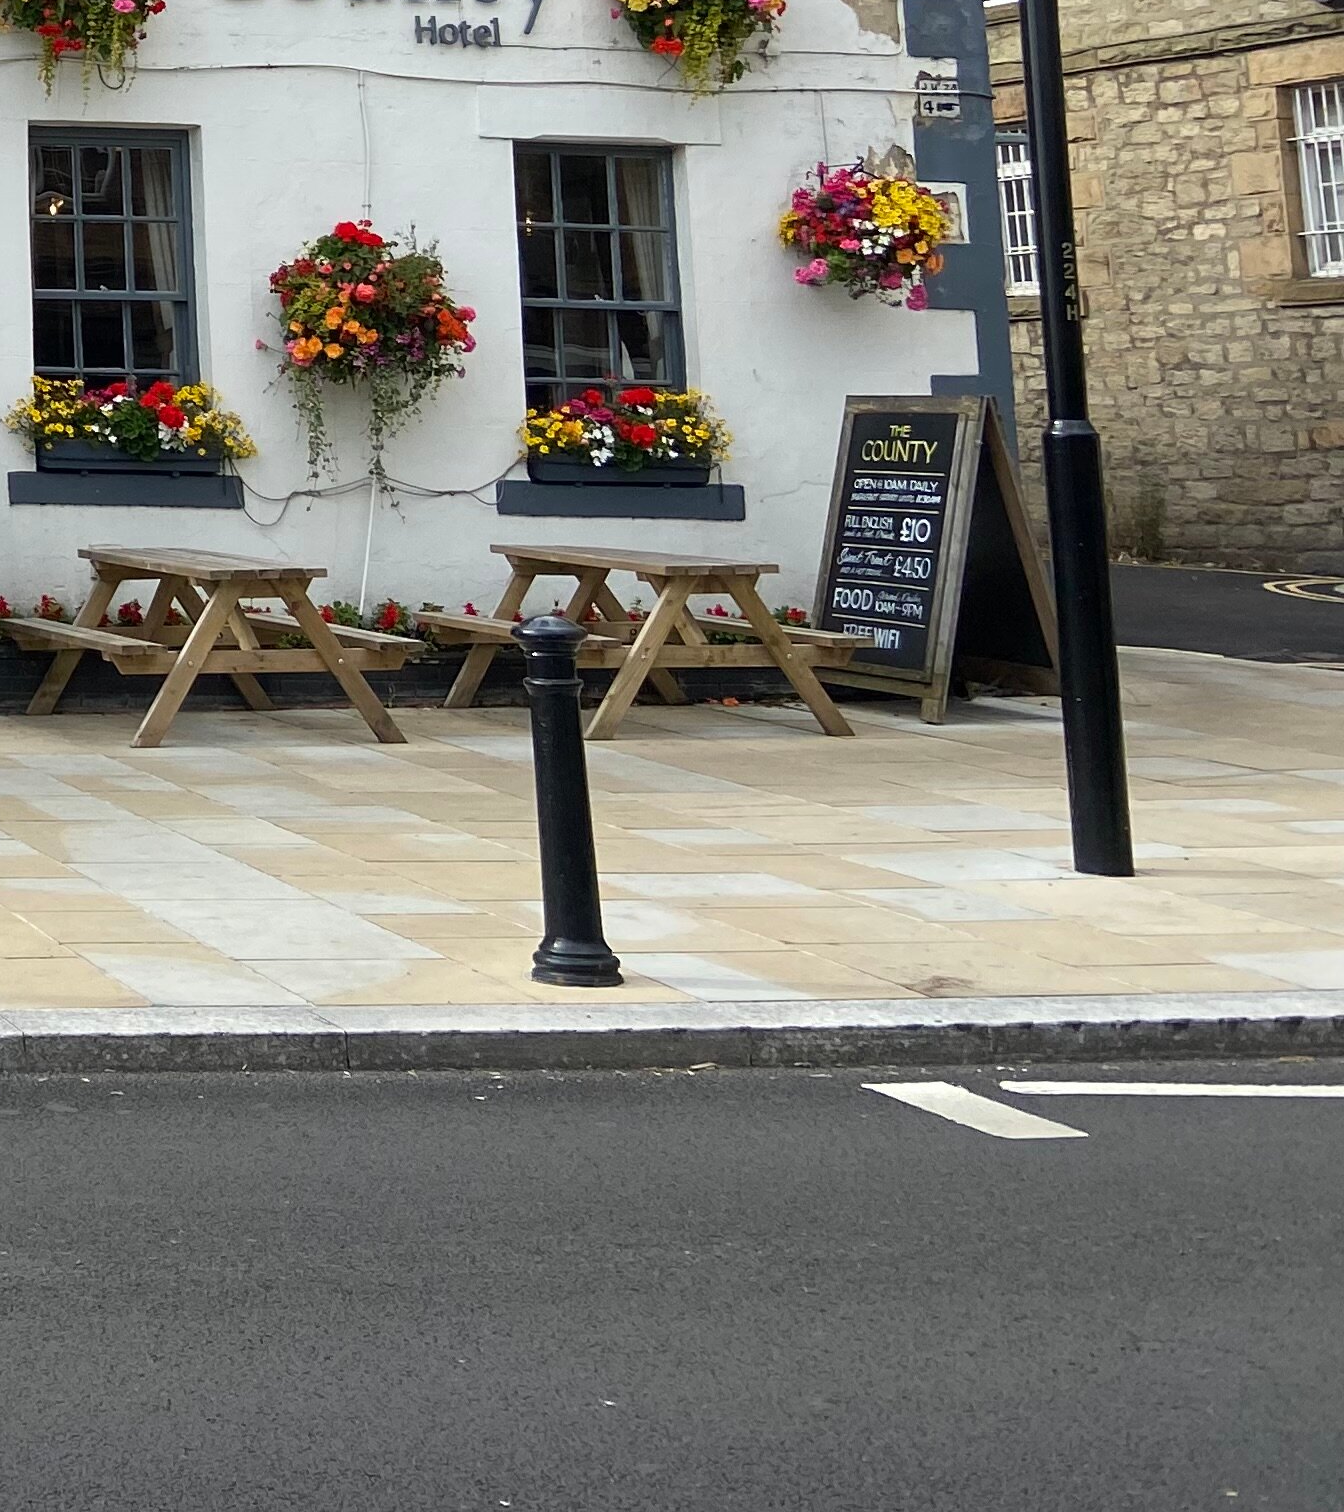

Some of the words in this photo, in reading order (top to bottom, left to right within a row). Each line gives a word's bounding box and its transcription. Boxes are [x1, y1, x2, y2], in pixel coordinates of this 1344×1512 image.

[414, 15, 502, 48] Hotel
[923, 100, 934, 114] 4
[889, 424, 912, 438] THE
[861, 440, 939, 465] COUNTY
[853, 478, 877, 490] OPEN
[884, 479, 907, 491] 10AM
[909, 480, 939, 493] DAILY
[861, 516, 894, 531] ENGLISH
[900, 517, 931, 543] £10
[832, 587, 874, 611] FOOD
[873, 627, 901, 649] WIFI
